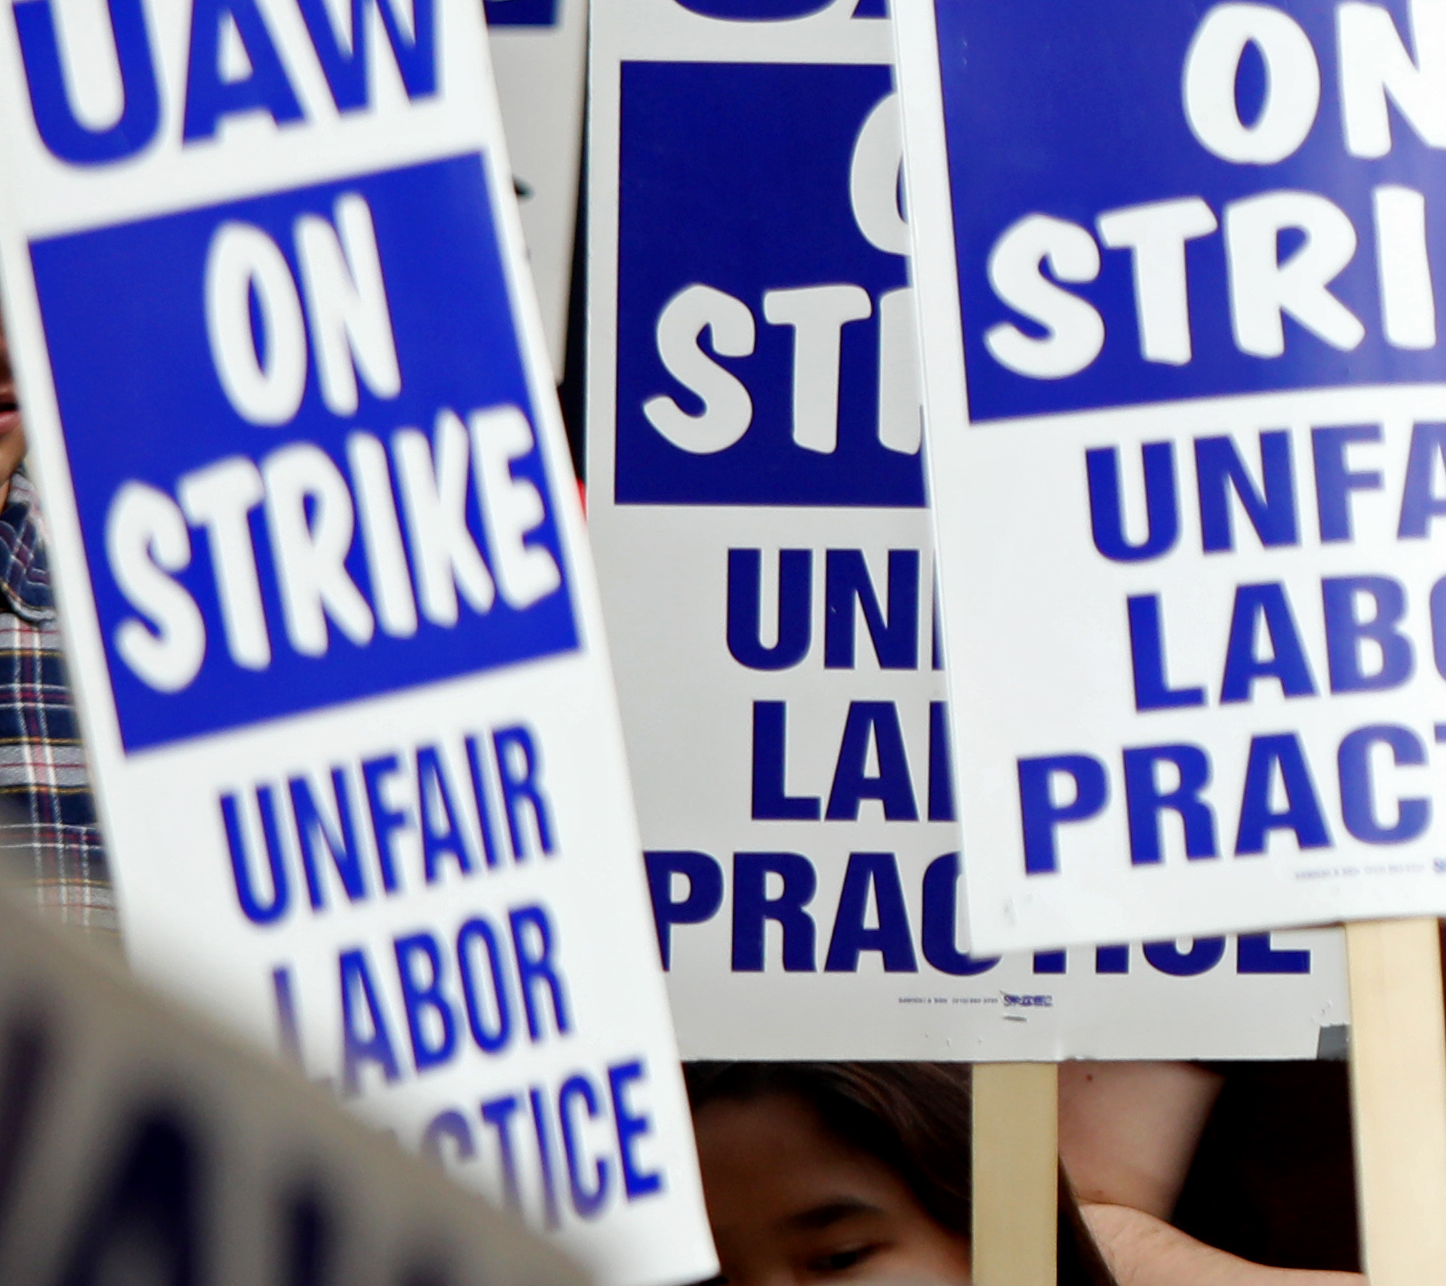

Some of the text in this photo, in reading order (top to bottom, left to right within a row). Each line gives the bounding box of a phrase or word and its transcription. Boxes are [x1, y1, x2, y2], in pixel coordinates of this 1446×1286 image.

[205, 191, 402, 431] ON
[104, 403, 564, 695] STRIKE
[220, 723, 560, 931] UNFAIR
[650, 850, 1312, 975] PRAC
[270, 903, 576, 1107] LABOR
[420, 1057, 664, 1231] TICE
